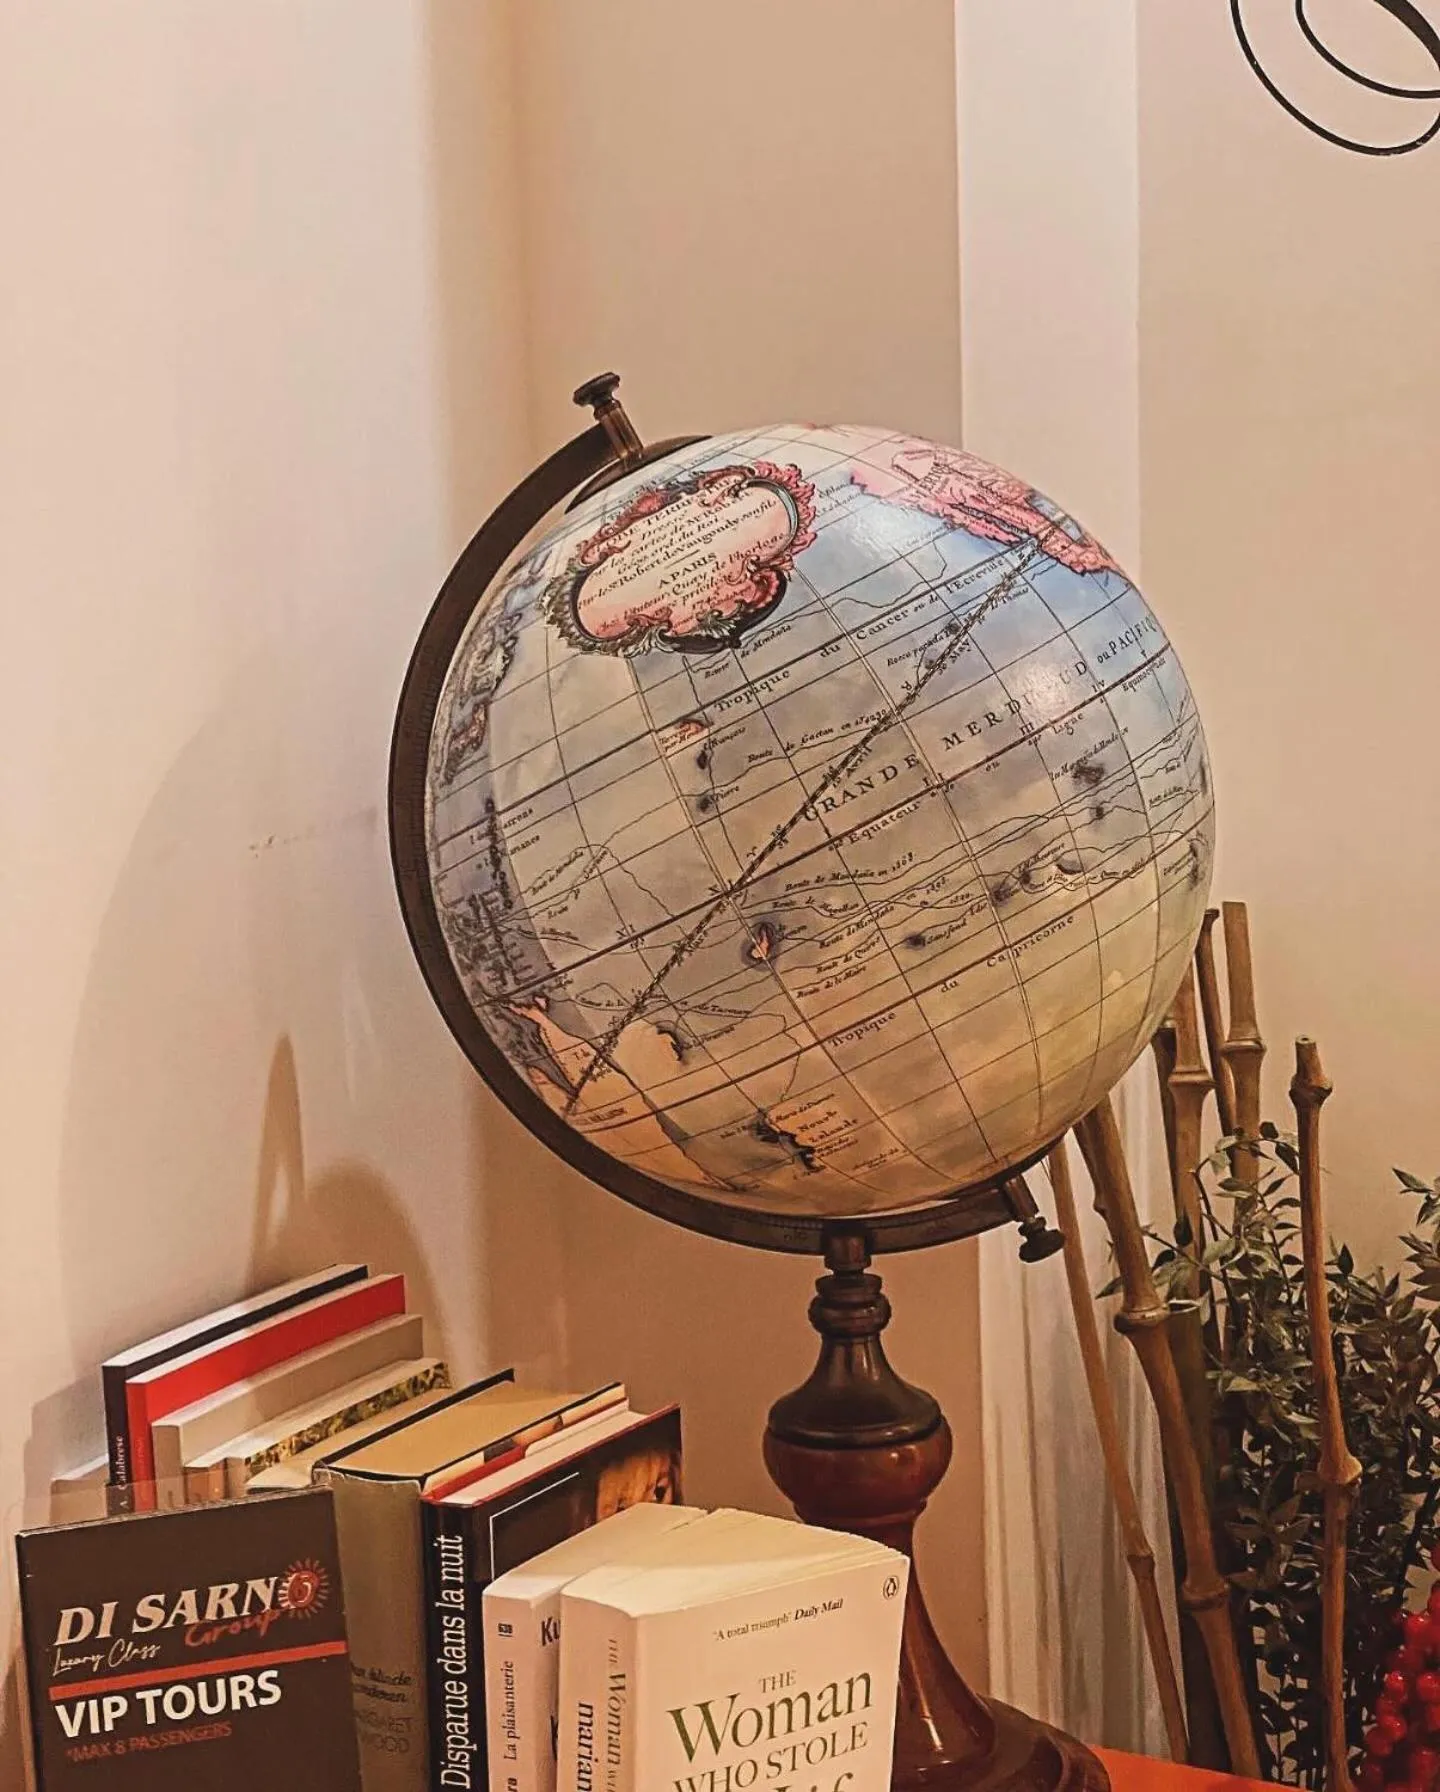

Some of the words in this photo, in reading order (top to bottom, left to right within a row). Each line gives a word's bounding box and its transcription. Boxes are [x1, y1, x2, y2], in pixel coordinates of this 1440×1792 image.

[671, 552, 716, 579] PARIS
[715, 670, 792, 714] Tropique
[819, 641, 840, 658] du
[857, 608, 908, 640] Cancer
[803, 753, 920, 822] GRANDE
[942, 709, 1000, 750] MER
[828, 1013, 897, 1048] Tropique
[940, 979, 960, 994] du
[985, 914, 1075, 969] Capricorne
[433, 1535, 464, 1584] nuit
[53, 1601, 119, 1646] DI
[435, 1588, 465, 1611] la
[795, 1606, 820, 1622] Daily
[820, 1597, 844, 1614] Mail
[437, 1615, 467, 1675] dans
[55, 1695, 128, 1738] VIP
[136, 1669, 282, 1725] TOURS
[500, 1660, 521, 1741] plaisanterie
[758, 1669, 797, 1694] THE
[128, 1720, 233, 1752] PASSENGERS
[440, 1680, 477, 1790] Disparue
[607, 1673, 627, 1766] Woman
[666, 1671, 873, 1764] Woman
[504, 1743, 517, 1761] La
[672, 1759, 759, 1792] WHO
[766, 1721, 868, 1781] STOLE
